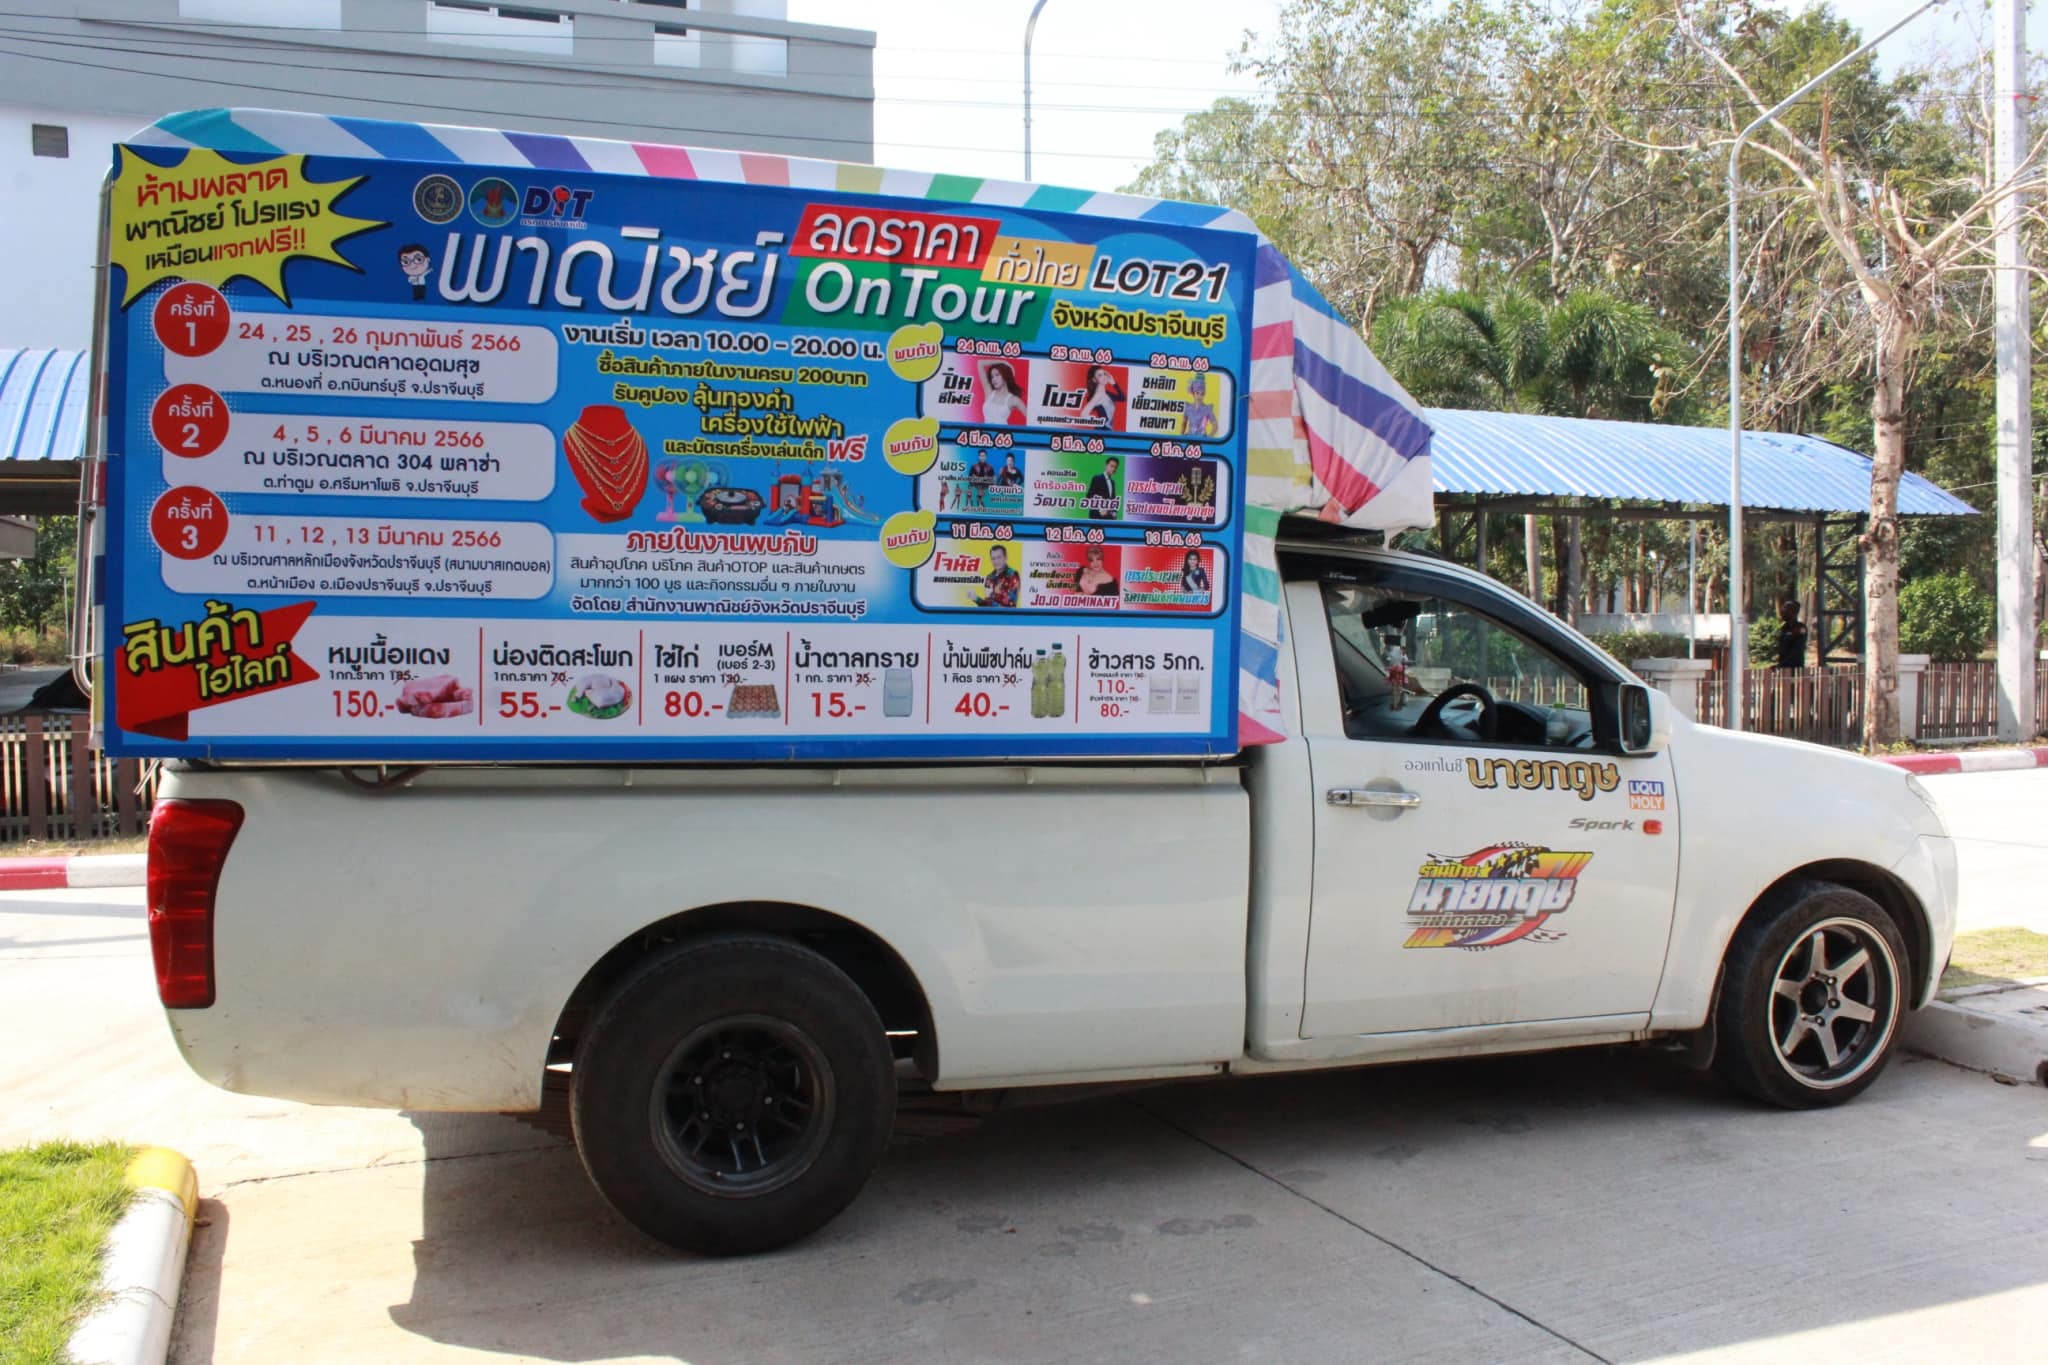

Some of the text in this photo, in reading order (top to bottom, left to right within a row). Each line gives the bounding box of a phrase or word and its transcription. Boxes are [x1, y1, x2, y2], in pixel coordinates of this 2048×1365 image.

[137, 168, 288, 207] ห้ามพลาด
[521, 185, 595, 218] DIT
[126, 199, 320, 241] พาณิชย์ โปรแรง
[810, 214, 980, 262] ลดราคา
[438, 225, 785, 318] พาณิชย์
[997, 242, 1080, 286] ทั่วไทย
[170, 294, 215, 317] ครั้งที่
[186, 322, 196, 347] 1
[1053, 303, 1225, 346] จังหวัดปราจีนบุรี
[366, 328, 464, 351] กุมภาพันธ์
[471, 333, 521, 351] 2566
[564, 320, 883, 359] งานเริ่ม เวลา 10.00 20.00 น.
[894, 342, 936, 360] พบกับ
[957, 340, 1020, 355] 24 ก.พ. 66
[268, 349, 480, 378] ณ บริเวณตลาดอุดมสุข
[1051, 347, 1111, 362] 25 ก.พ. 66
[1151, 355, 1208, 370] 26 ก.พ. 66
[261, 372, 484, 399] ต.หนองกี่ อ.กบินทร์บุรี จ.ปราจีนบุรี
[168, 395, 214, 418] ครั้งที่
[615, 383, 792, 413] รับคูปอง ลุ้นทองคำ
[701, 407, 843, 437] เครื่องใช้ไฟฟ้า
[182, 423, 200, 448] 2
[360, 424, 426, 446] มีนาคม
[434, 430, 484, 448] 2566
[890, 436, 931, 454] พบกับ
[957, 432, 967, 444] 4
[995, 434, 1012, 447] 66
[1052, 437, 1060, 449] 5
[1088, 439, 1103, 451] 66
[244, 451, 265, 465] ณ
[273, 448, 389, 469] บริเวณตลาด
[397, 454, 433, 470] 304
[665, 436, 867, 461] และบัตรเครื่องเล่นเด็ก ฟรี
[1151, 443, 1160, 455] 6
[1186, 446, 1201, 458] 66
[264, 474, 314, 493] ต.ท่าตูม
[406, 479, 479, 497] จ.ปราจีนบุรี
[167, 496, 213, 520] ครั้งที่
[181, 525, 198, 550] 3
[378, 525, 444, 546] มีนาคม
[452, 530, 501, 548] 2566
[626, 527, 817, 554] ภายในงานพบกับ
[887, 530, 928, 548] พบกับ
[952, 524, 966, 537] 11
[996, 526, 1012, 539] 66
[1046, 528, 1060, 540] 12
[1088, 529, 1103, 541] 66
[1146, 532, 1160, 544] 13
[1186, 533, 1201, 545] 66
[570, 556, 647, 573] สินค้าอุปโภค
[652, 558, 693, 572] บริโภค
[772, 561, 865, 575] และสินค้าเกษตร
[247, 576, 492, 596] ต.หน้าเมือง อ.เมืองปราจีนบุรี จ.ปราจีนบุรี
[580, 576, 631, 589] มากกว่า
[635, 578, 660, 590] 100
[664, 580, 682, 594] บูธ
[794, 580, 856, 593] ภายในงาน
[572, 596, 866, 618] จัดโดย สำนักงานพาณิชย์จังหวัดปราจีนบุรี
[1030, 594, 1060, 606] JOJO
[1064, 595, 1118, 608] DOMINANT
[125, 600, 260, 674] สินค้า
[328, 633, 450, 671] หมูเนื้อแดง
[493, 641, 633, 667] น่องติดสะโพก
[654, 643, 699, 668] ไข่ไก่
[795, 638, 919, 668] น้ำตาลทราย
[943, 640, 1032, 669] น้ำมันพืชปาล์ม
[1089, 648, 1155, 670] ข้าวสาร
[689, 674, 716, 683] ราคา
[827, 674, 853, 683] ราคา
[976, 674, 1000, 683] ราคา
[1629, 781, 1663, 795] LIQUI
[1631, 796, 1664, 809] MOLY
[1568, 818, 1635, 832] Spark
